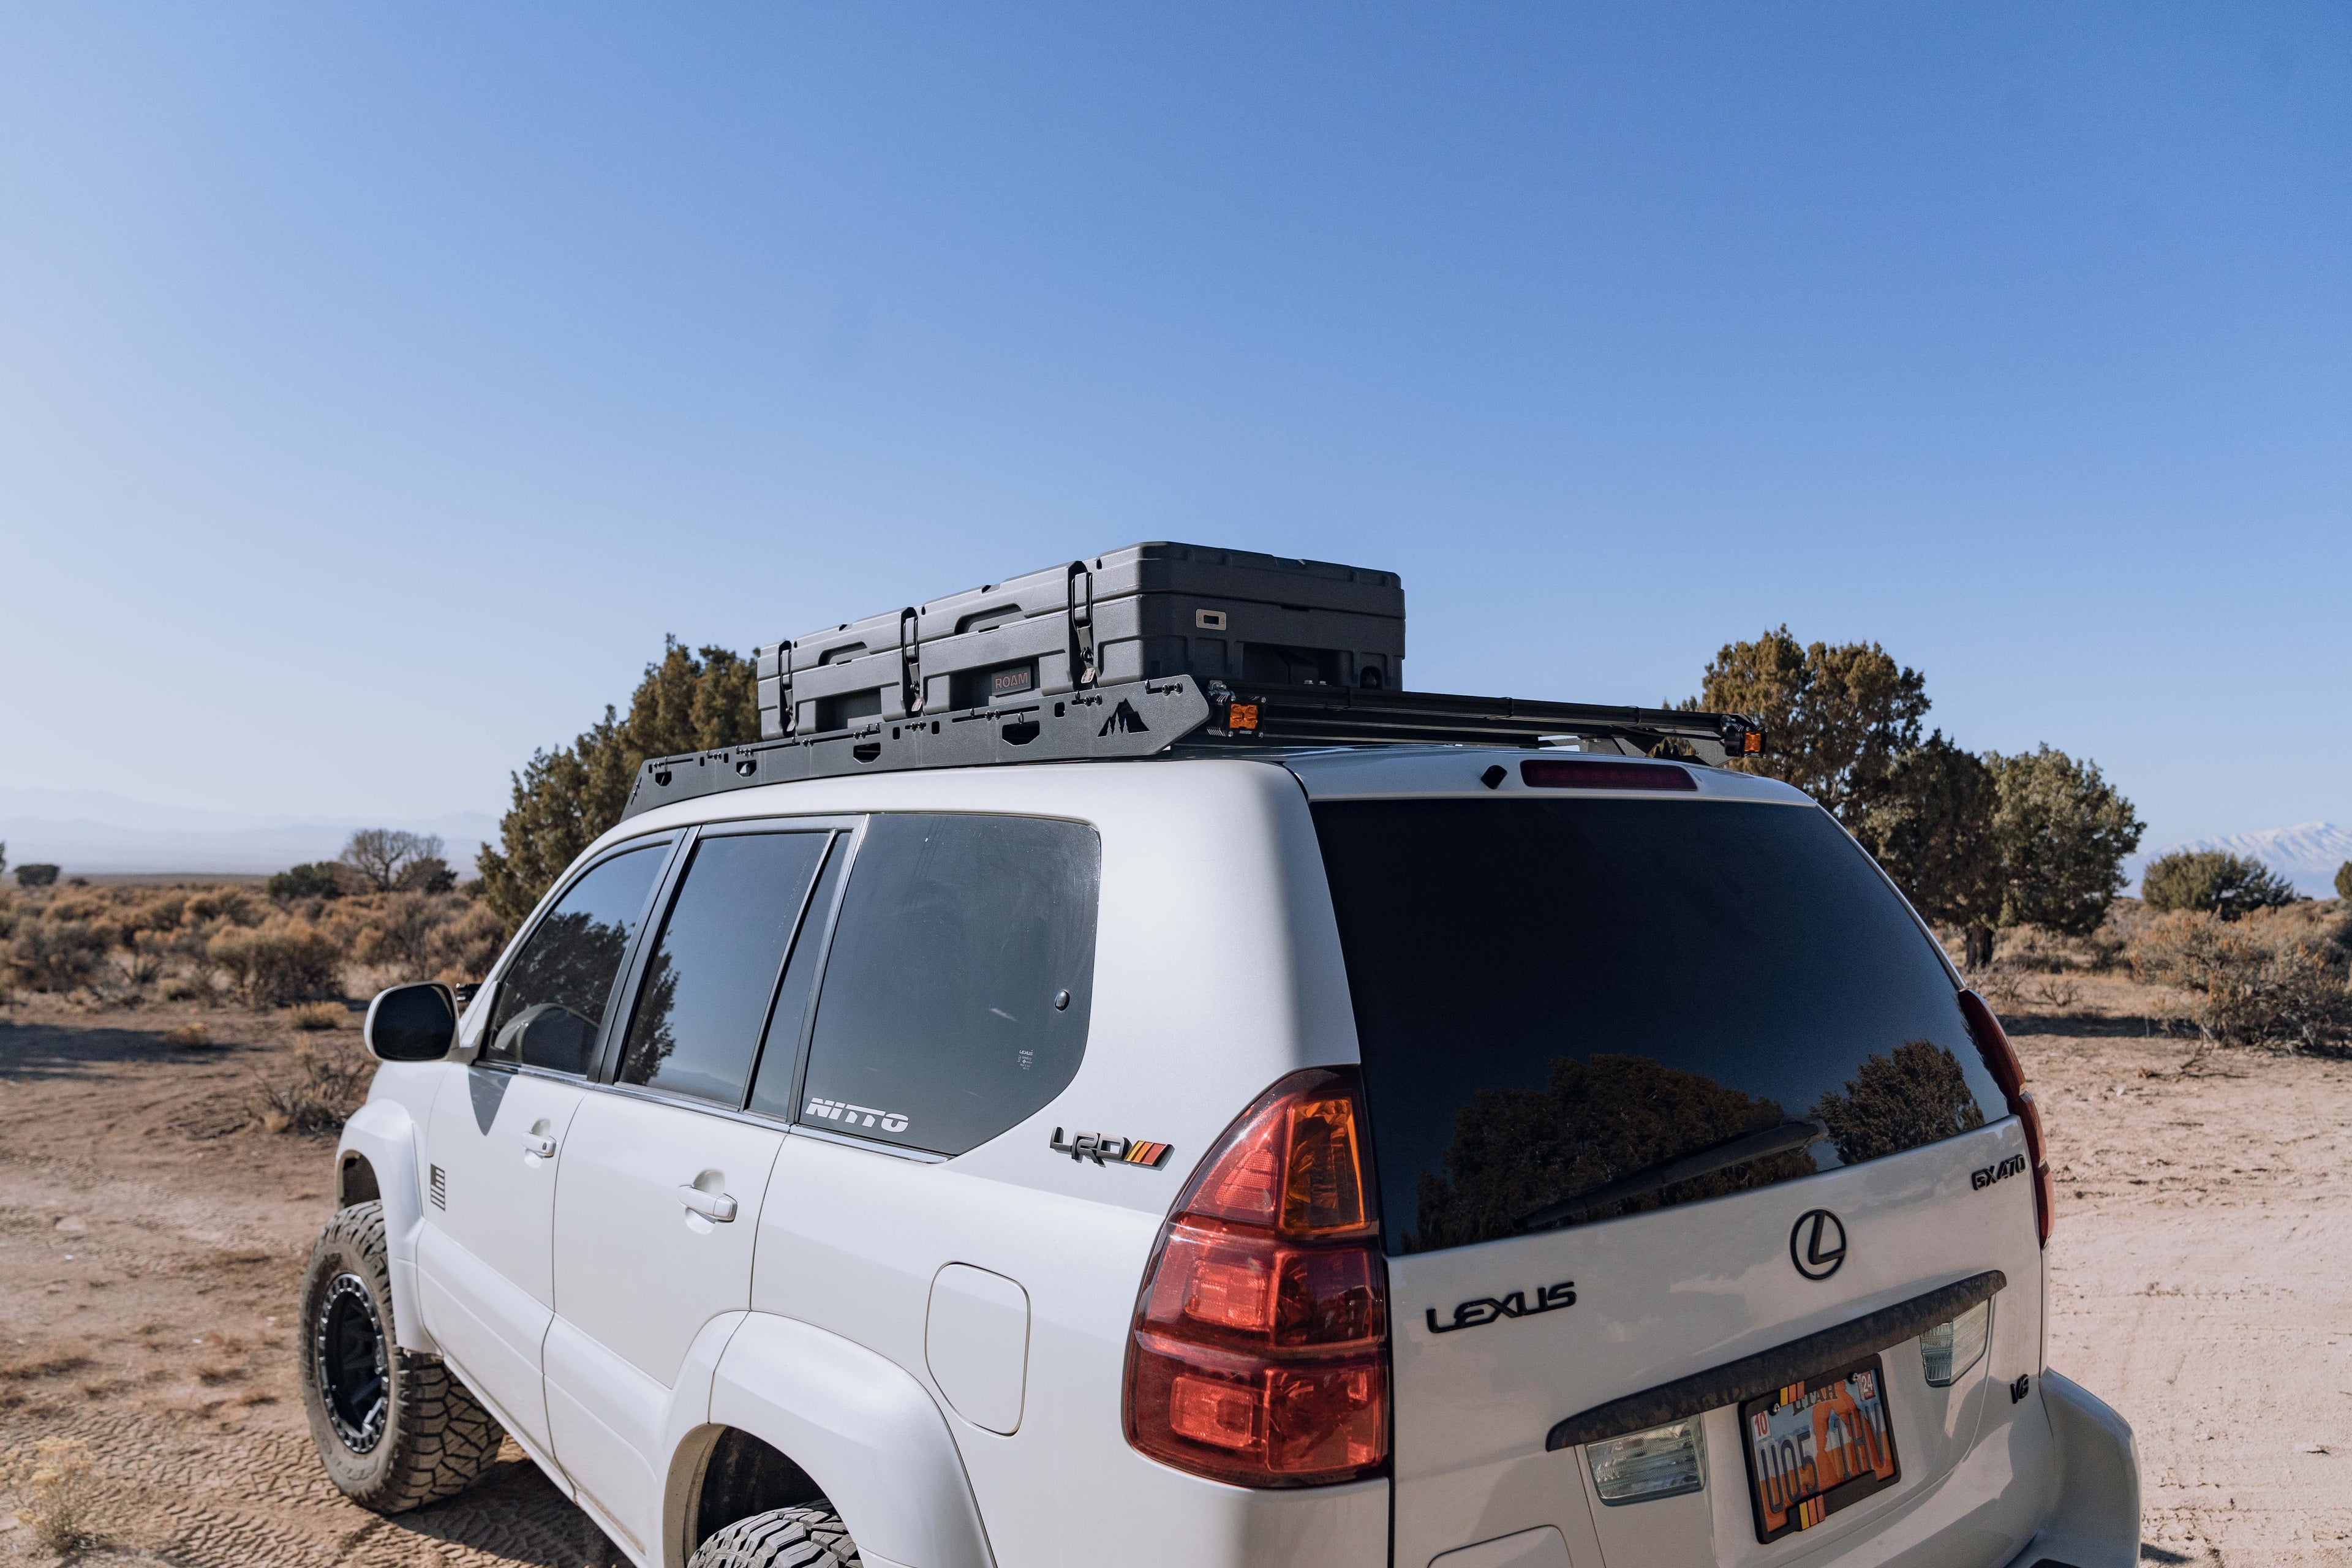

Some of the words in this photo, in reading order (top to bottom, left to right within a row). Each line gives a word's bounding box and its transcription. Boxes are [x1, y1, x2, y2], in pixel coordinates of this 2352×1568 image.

[995, 672, 1028, 690] ROAM
[805, 1097, 909, 1133] NITTO
[1426, 1281, 1577, 1333] LEXUS
[1862, 1373, 1872, 1393] 24
[2010, 1374, 2029, 1404] V8
[1754, 1412, 1768, 1437] 10
[1834, 1402, 1885, 1480] 1HV
